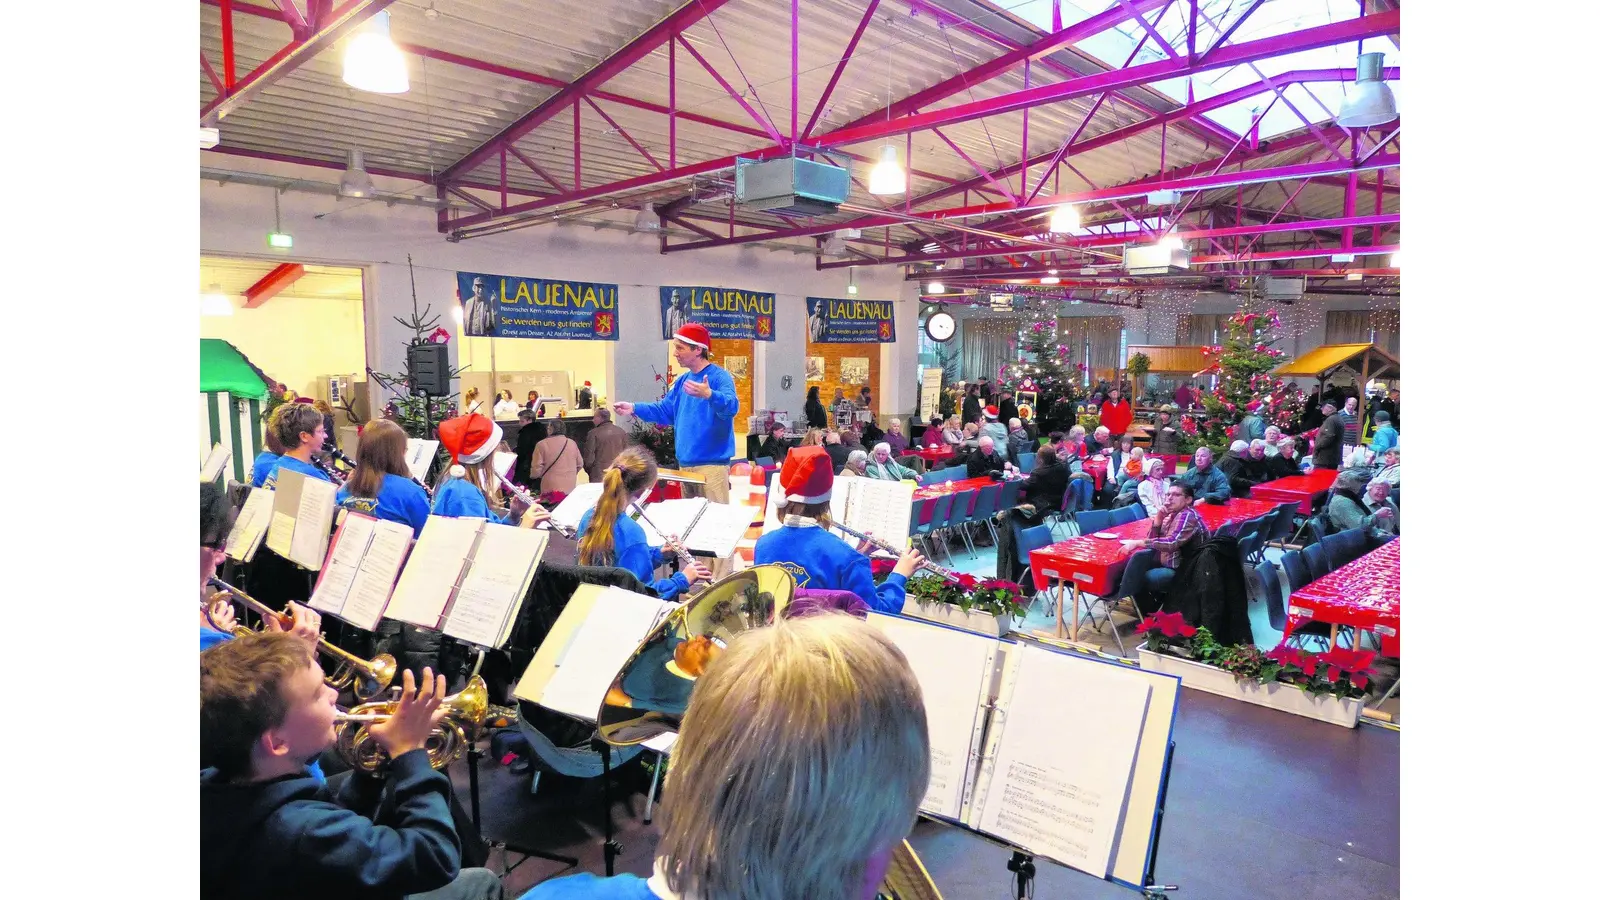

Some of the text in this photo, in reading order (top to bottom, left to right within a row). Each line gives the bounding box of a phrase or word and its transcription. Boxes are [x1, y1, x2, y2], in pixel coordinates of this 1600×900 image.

[500, 278, 615, 309] LAUENAU
[691, 289, 773, 315] LAUENAU
[829, 300, 892, 320] LAUENAU
[501, 316, 513, 325] Sie
[557, 320, 569, 329] gut
